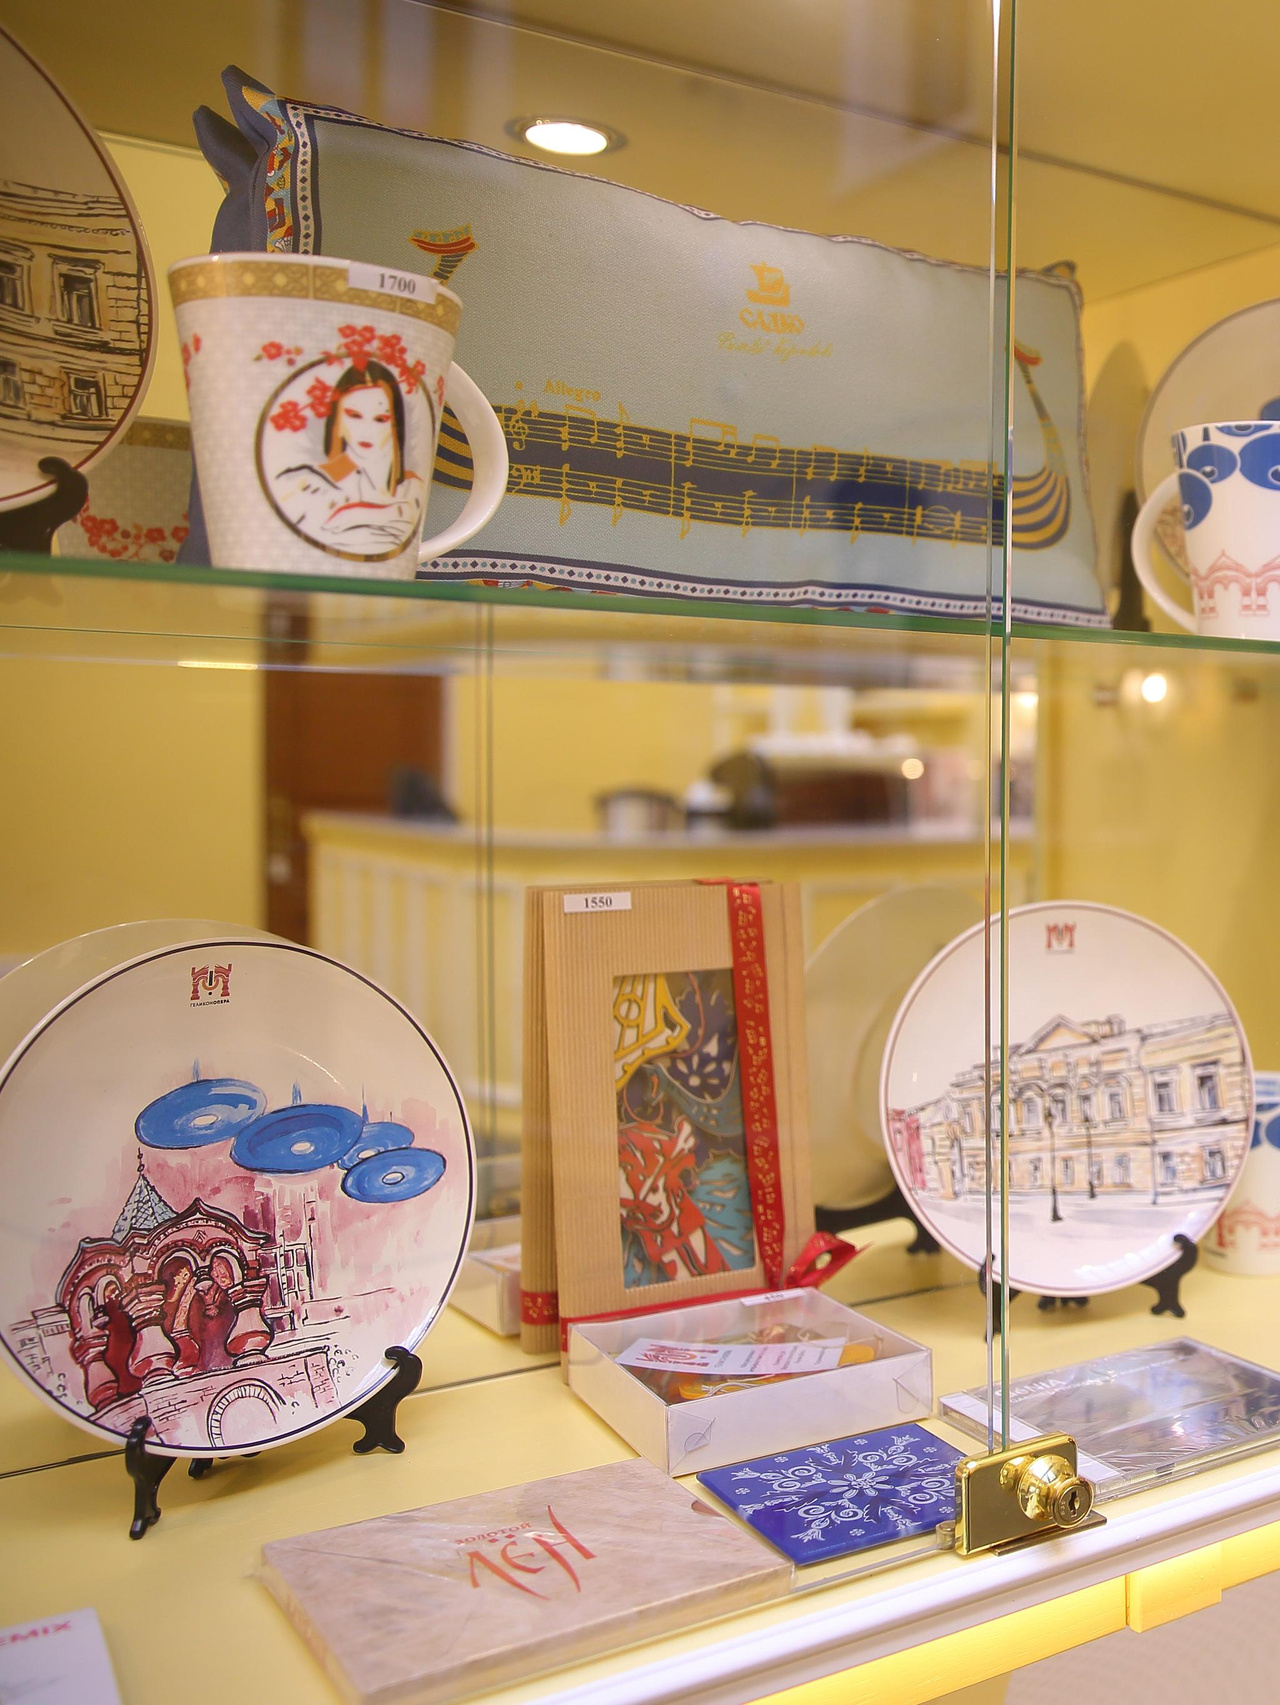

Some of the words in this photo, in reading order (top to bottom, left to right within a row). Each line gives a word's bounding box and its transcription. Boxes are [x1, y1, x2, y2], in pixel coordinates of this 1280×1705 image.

[379, 273, 416, 294] 1700
[542, 379, 601, 402] Allegro
[584, 896, 612, 908] 1550
